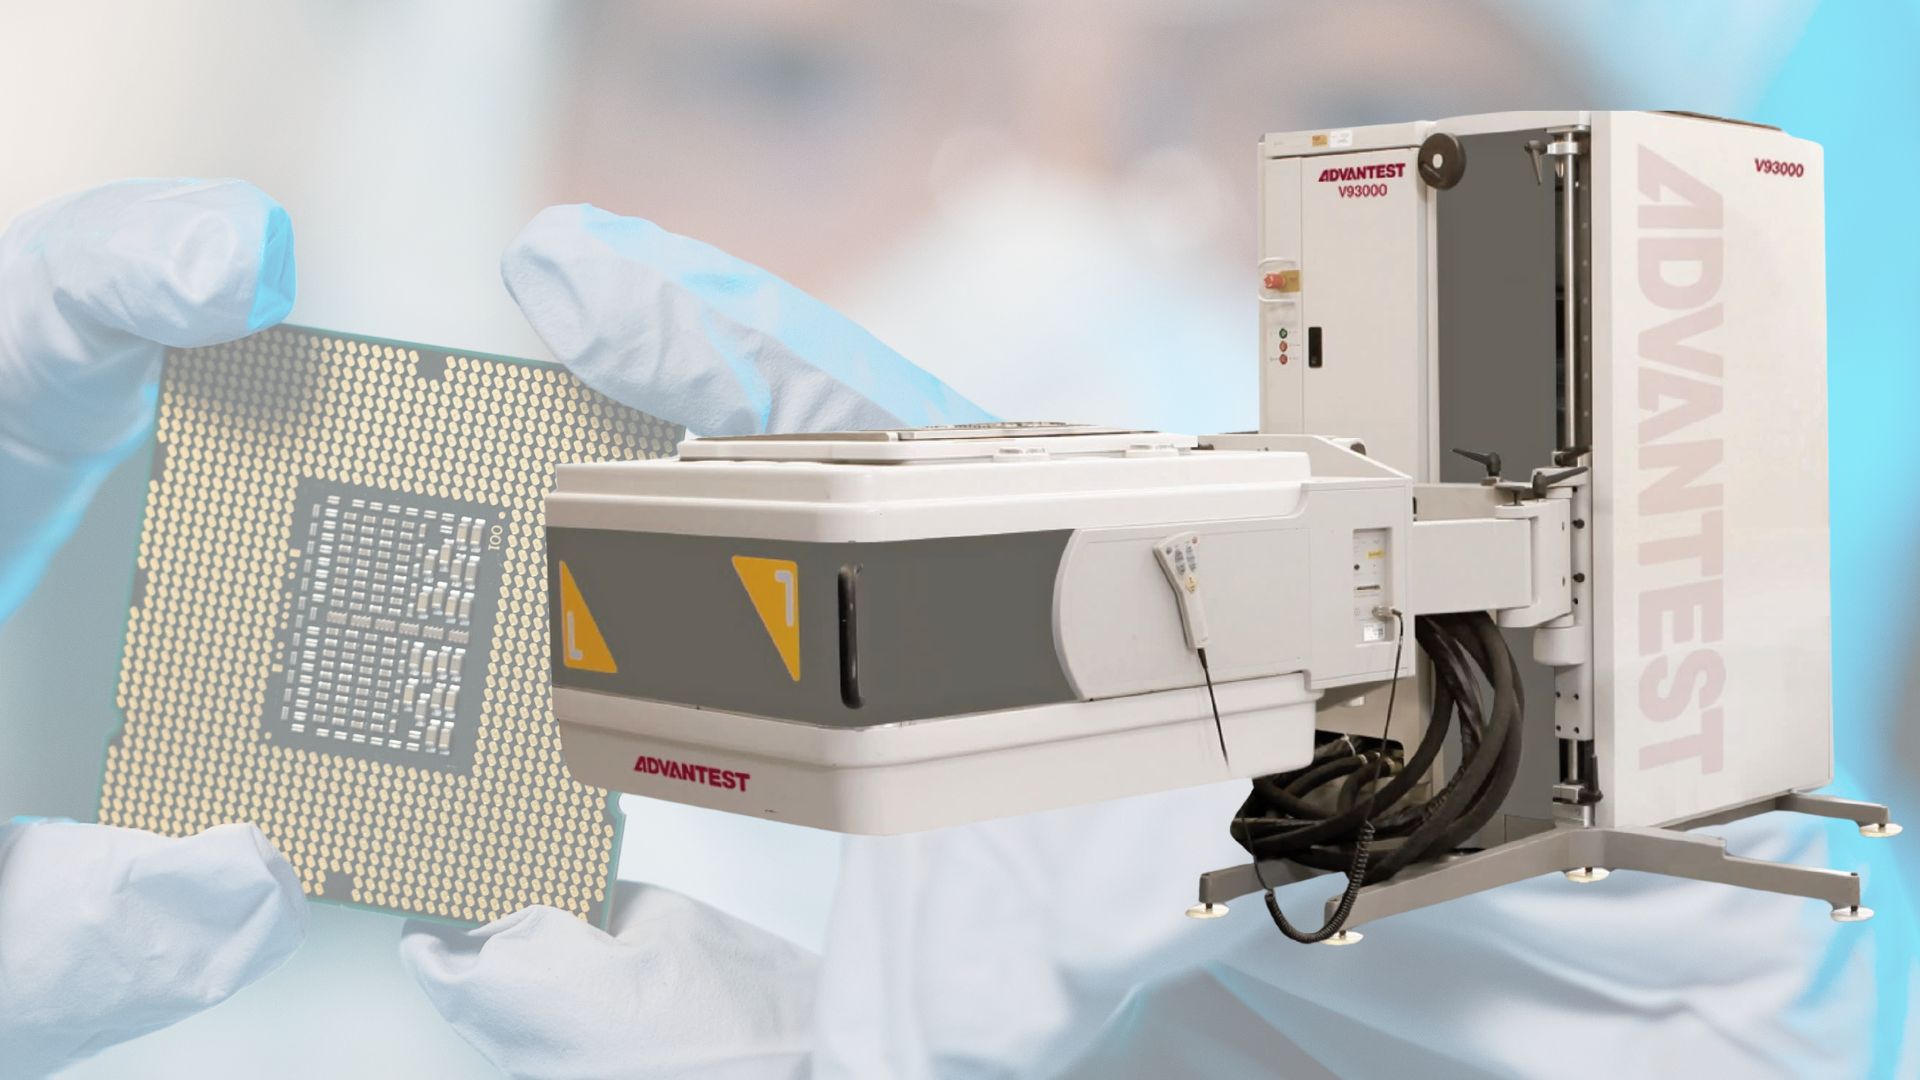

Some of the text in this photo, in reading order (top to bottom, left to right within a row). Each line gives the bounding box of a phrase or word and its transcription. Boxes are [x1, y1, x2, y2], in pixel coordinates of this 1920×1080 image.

[1318, 163, 1405, 182] ADVANTEST
[1754, 158, 1804, 178] V93000
[1339, 184, 1388, 198] V93000
[1638, 143, 1726, 774] ADVANTEST
[633, 755, 750, 792] ADVANTEST
